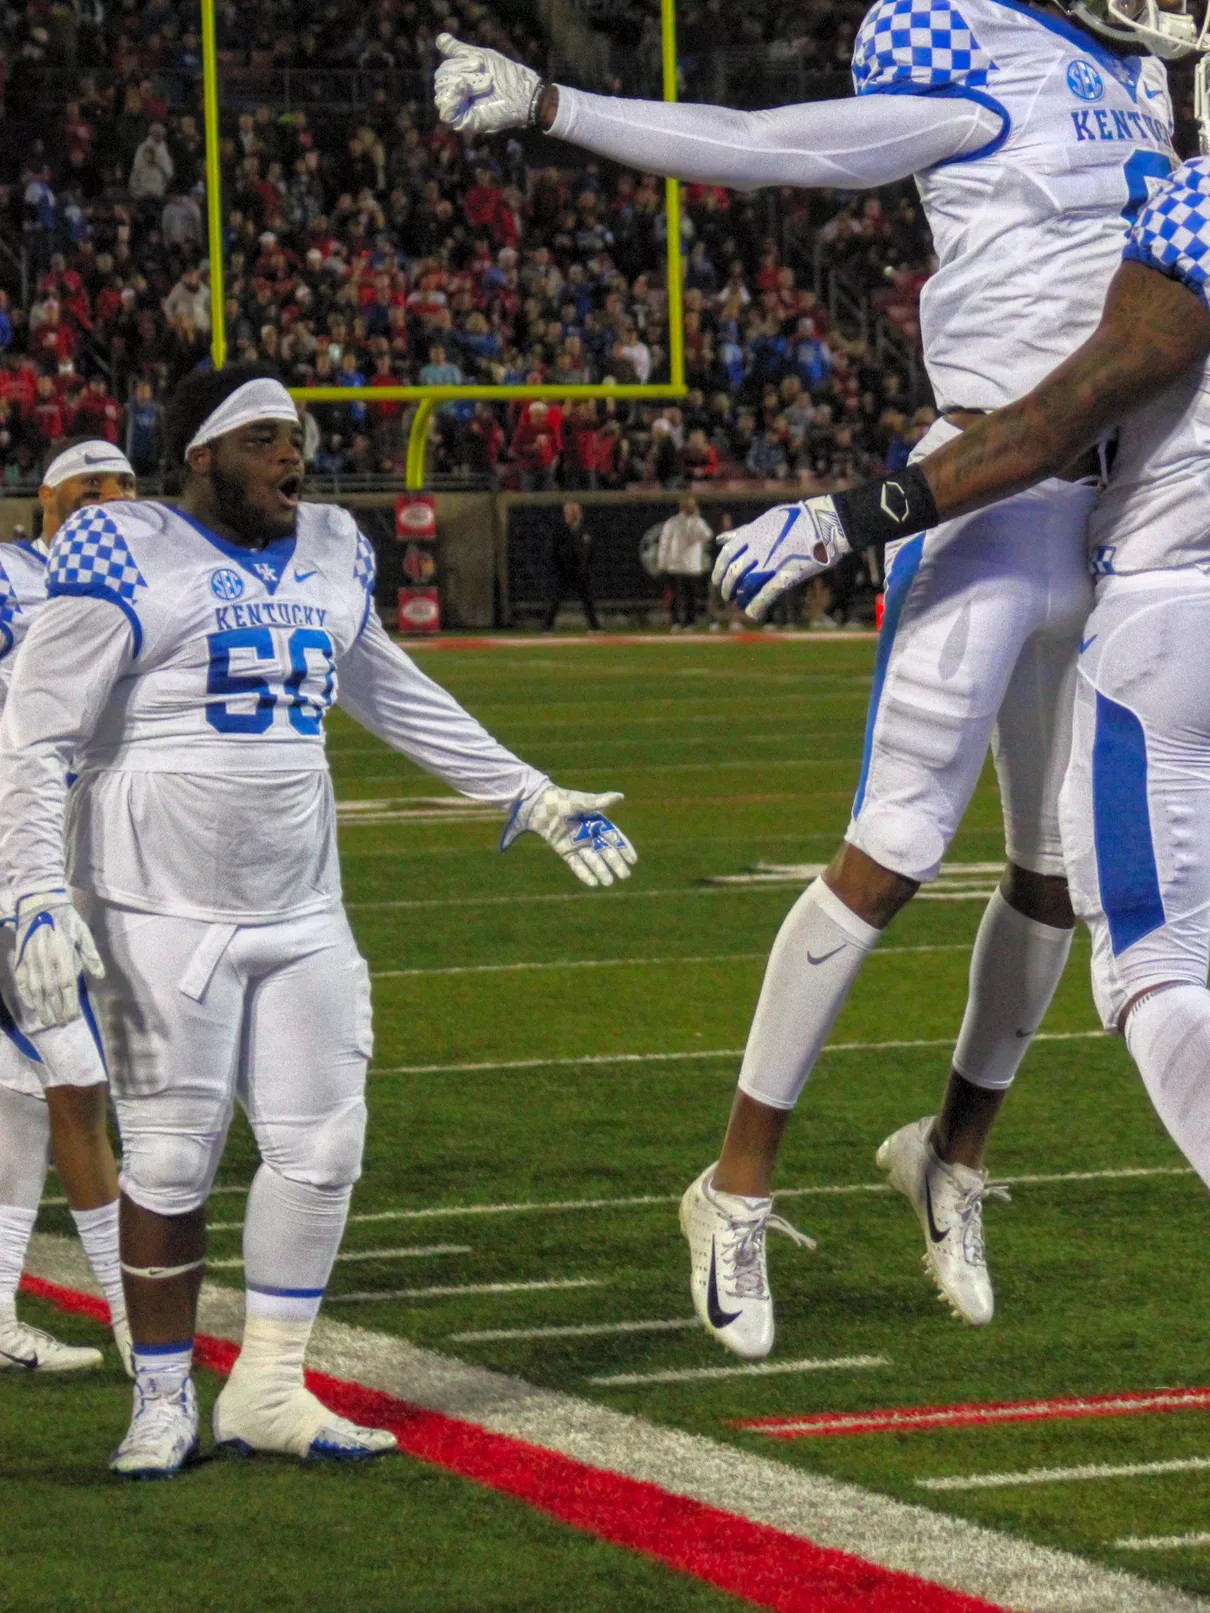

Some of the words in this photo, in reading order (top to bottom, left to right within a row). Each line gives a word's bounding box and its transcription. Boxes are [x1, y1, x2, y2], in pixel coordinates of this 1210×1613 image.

[210, 568, 244, 600] SEC
[215, 602, 327, 632] KENTUCKY
[205, 625, 336, 736] 50
